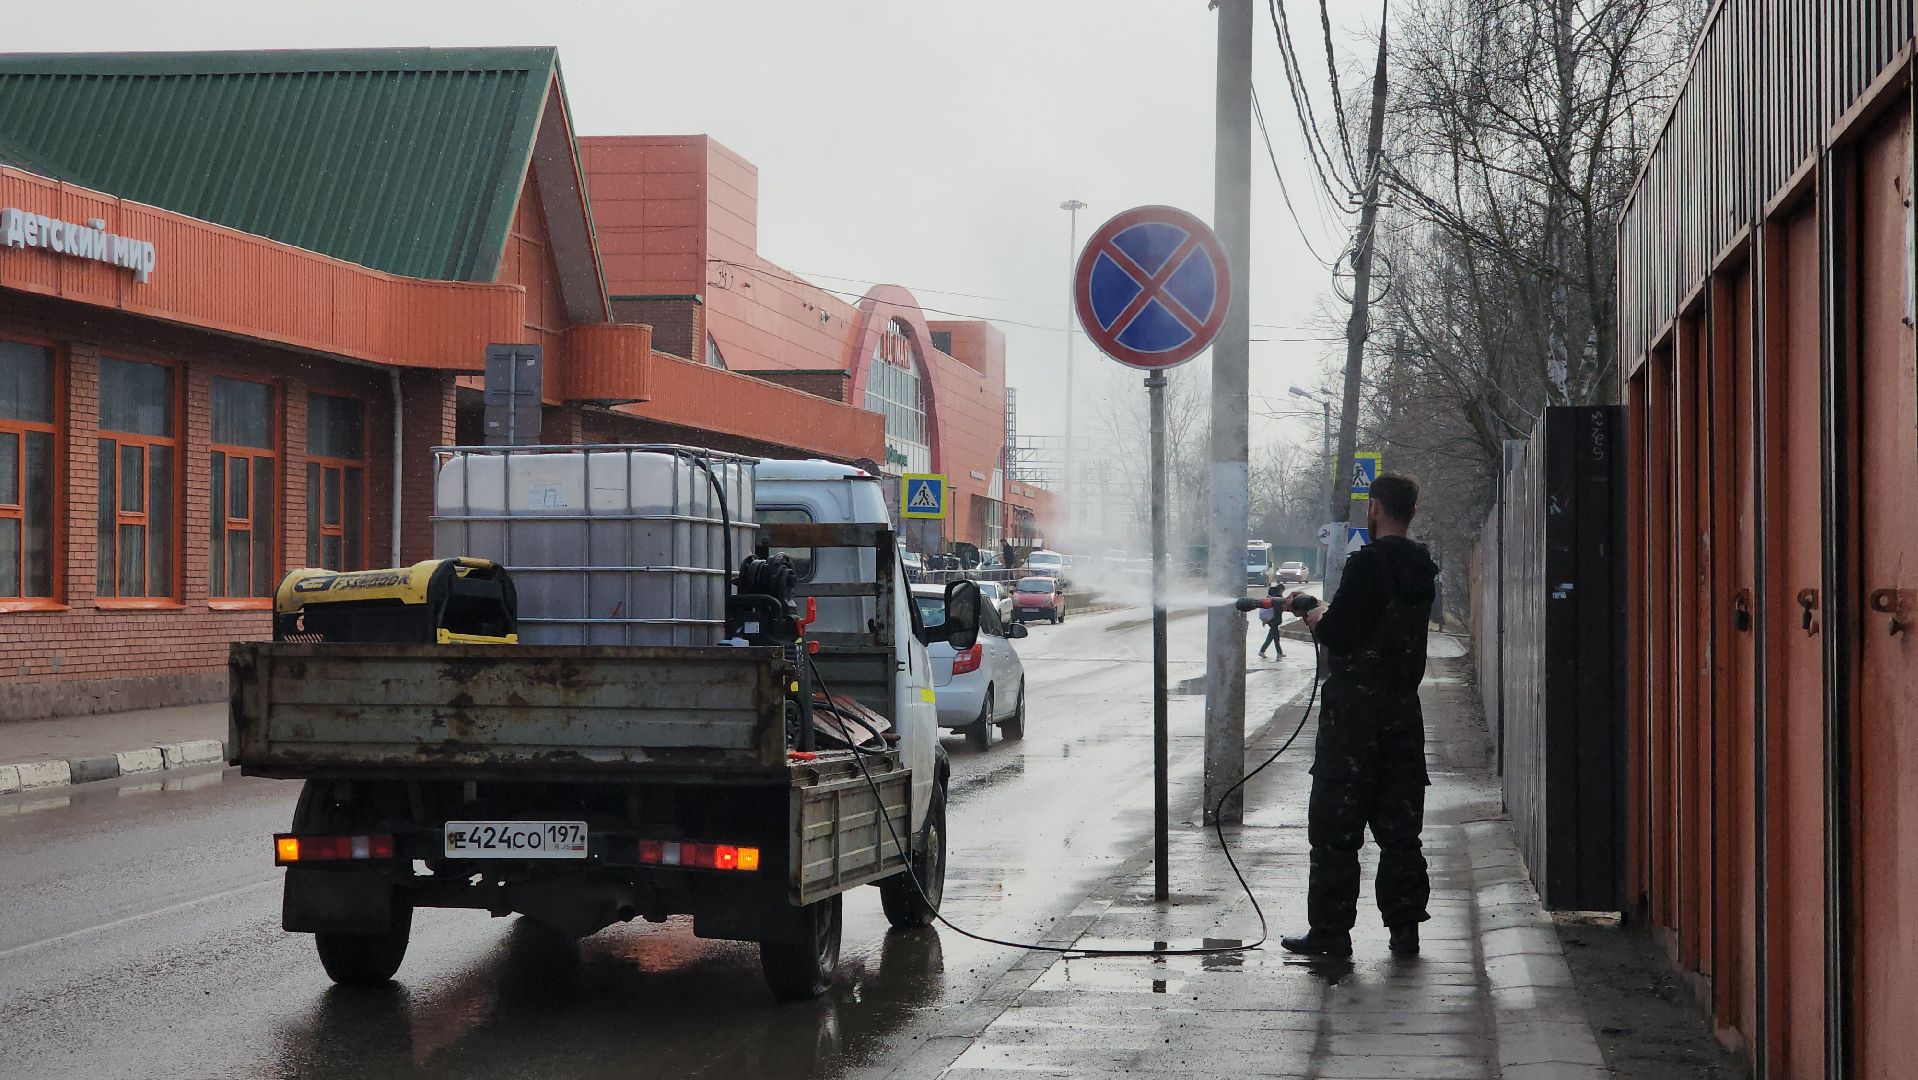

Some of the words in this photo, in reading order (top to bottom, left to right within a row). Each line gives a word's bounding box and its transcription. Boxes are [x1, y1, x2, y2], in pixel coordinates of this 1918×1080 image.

[5, 207, 107, 263] детский
[112, 234, 156, 284] мир
[547, 825, 580, 843] 197
